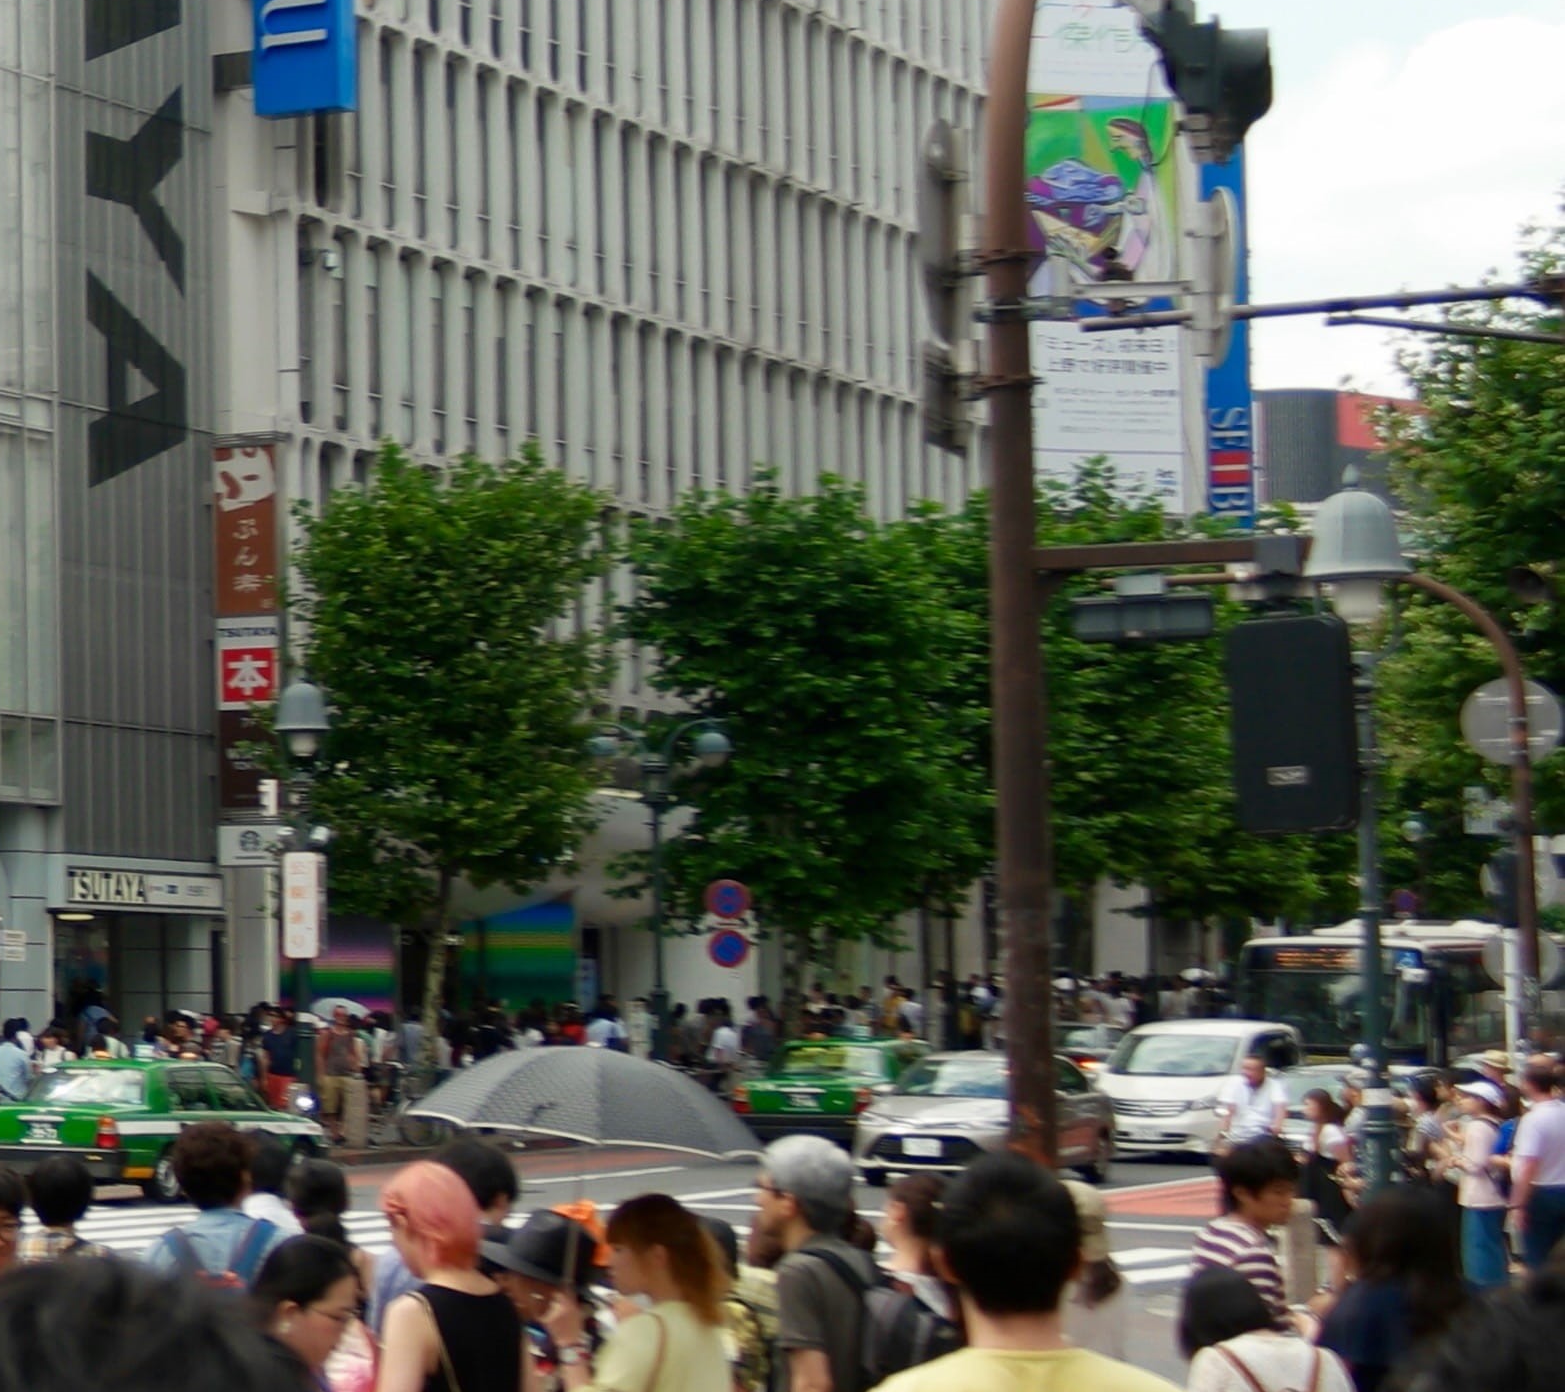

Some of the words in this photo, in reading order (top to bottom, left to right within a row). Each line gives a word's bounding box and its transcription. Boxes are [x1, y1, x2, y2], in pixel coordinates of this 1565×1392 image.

[1209, 407, 1250, 516] SEIB
[226, 654, 270, 696] 本
[67, 869, 147, 904] TSUTAYA
